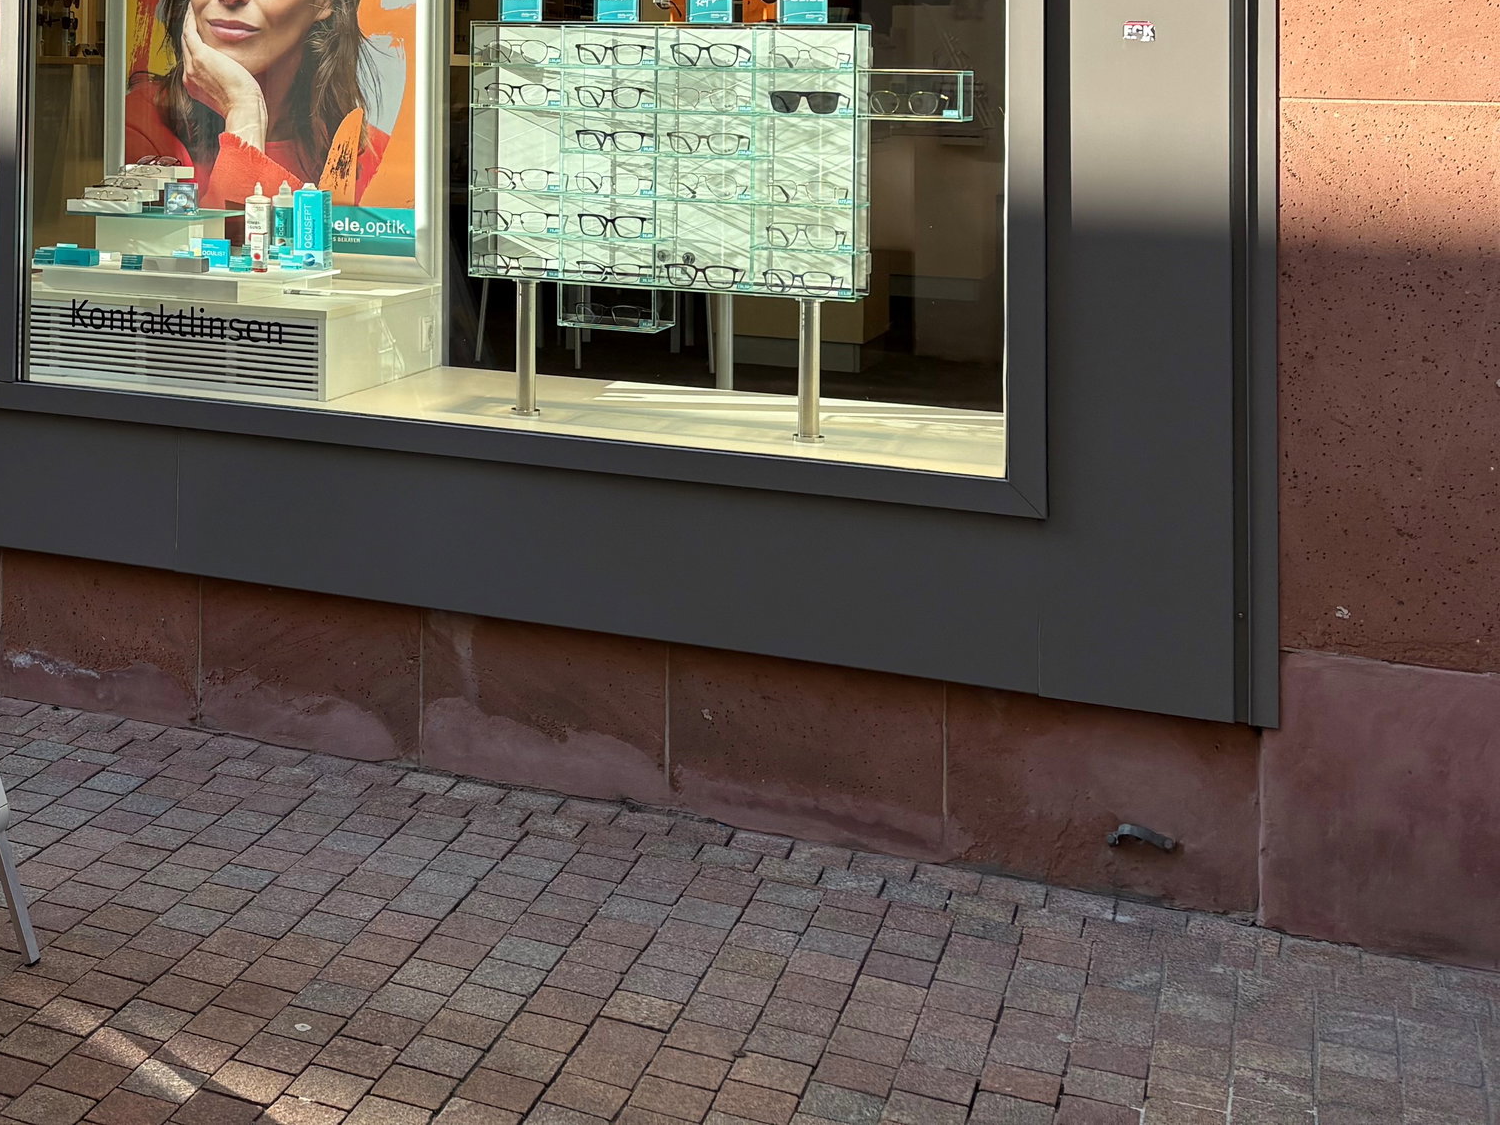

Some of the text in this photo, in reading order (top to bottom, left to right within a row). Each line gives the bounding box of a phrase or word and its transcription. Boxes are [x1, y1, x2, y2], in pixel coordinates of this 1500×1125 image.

[303, 204, 313, 249] OCUSEPT
[331, 216, 412, 237] ele,optik.
[71, 298, 283, 345] Kontaktlinsen
